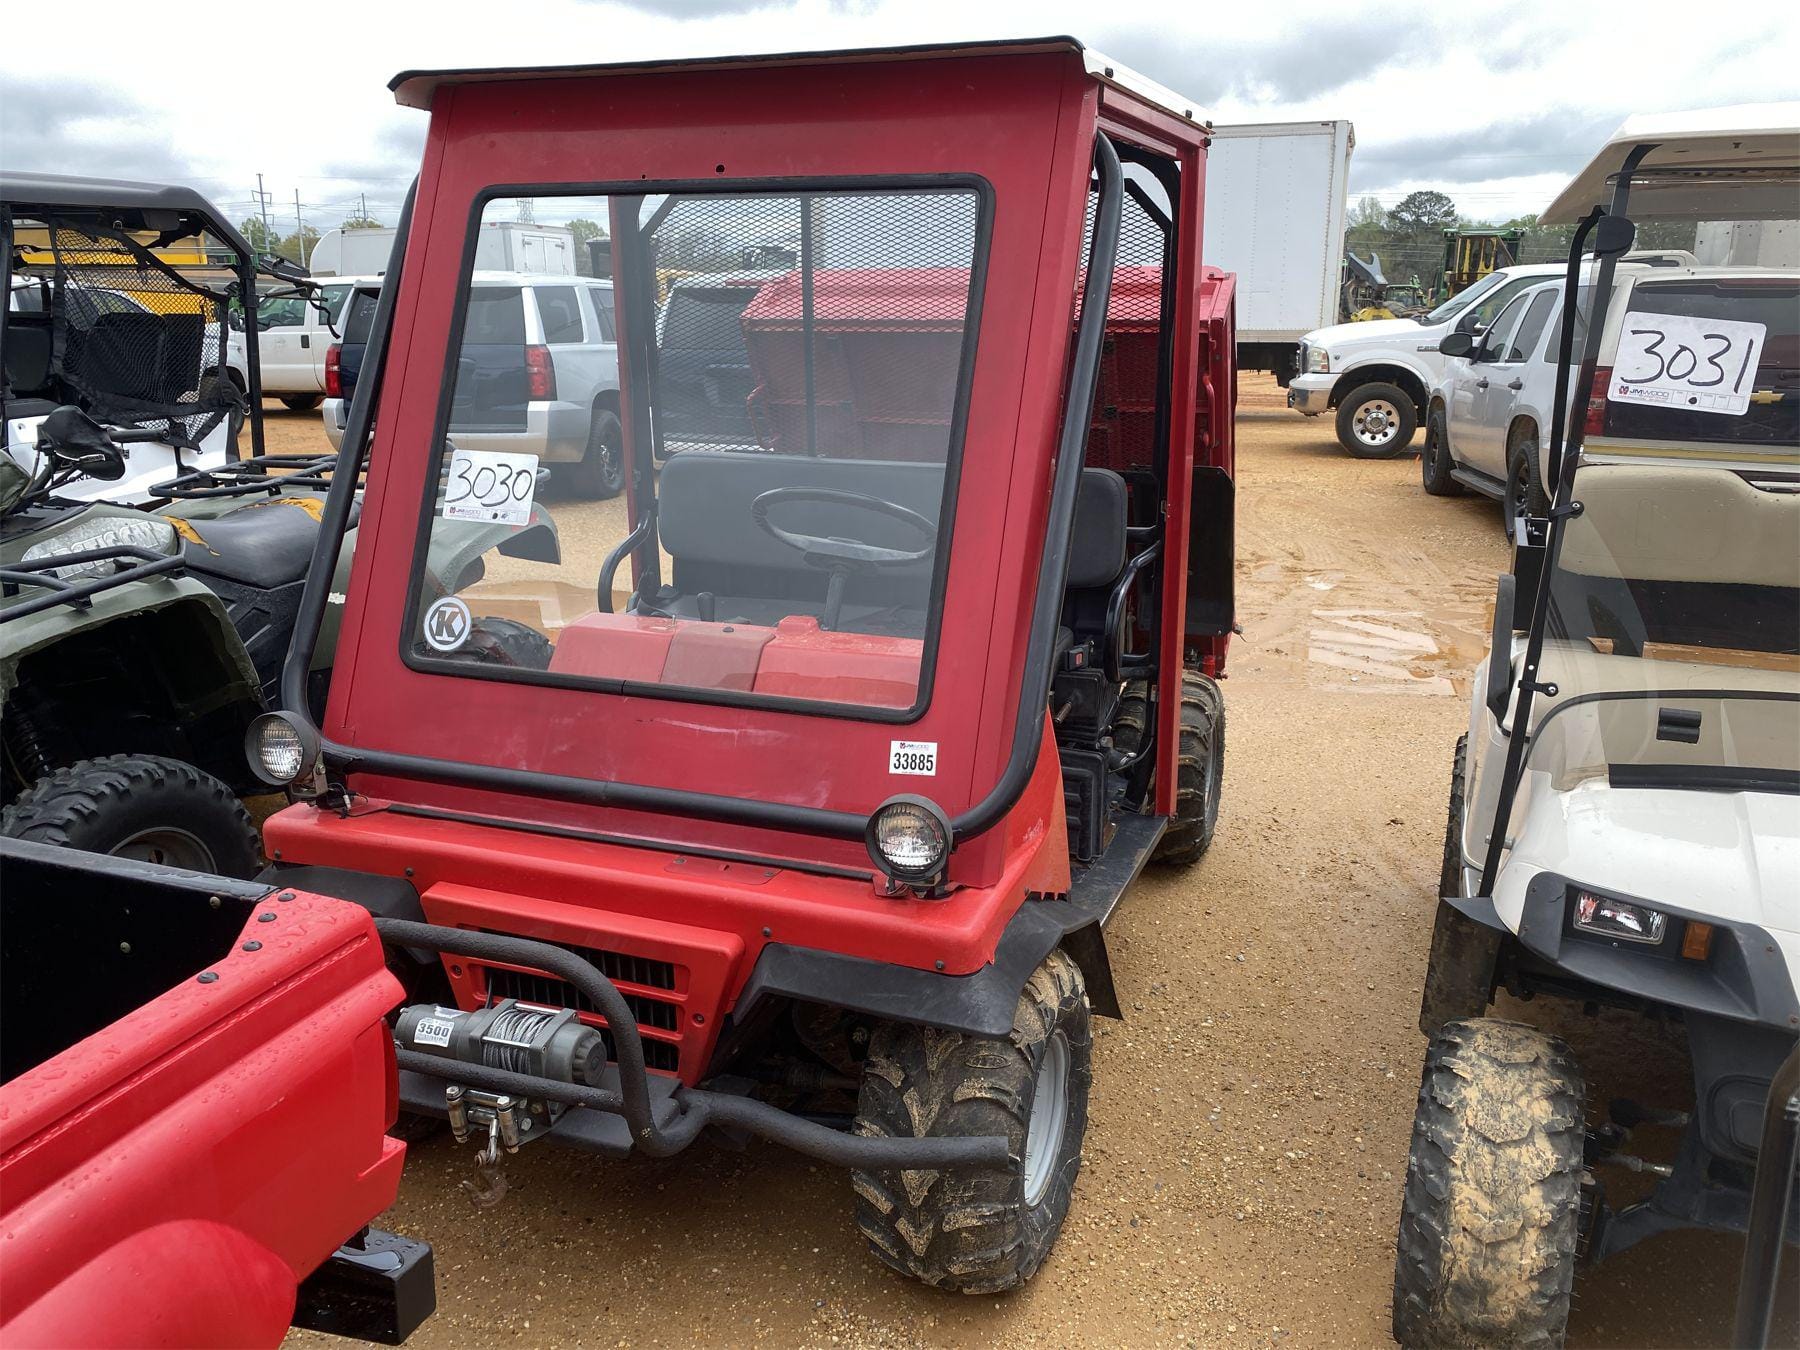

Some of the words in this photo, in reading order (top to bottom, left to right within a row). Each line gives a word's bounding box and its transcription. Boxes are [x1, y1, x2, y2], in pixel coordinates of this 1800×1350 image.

[1620, 329, 1754, 394] 3031
[444, 458, 533, 507] 3030
[893, 752, 934, 772] 33885
[418, 1022, 450, 1038] 3500
